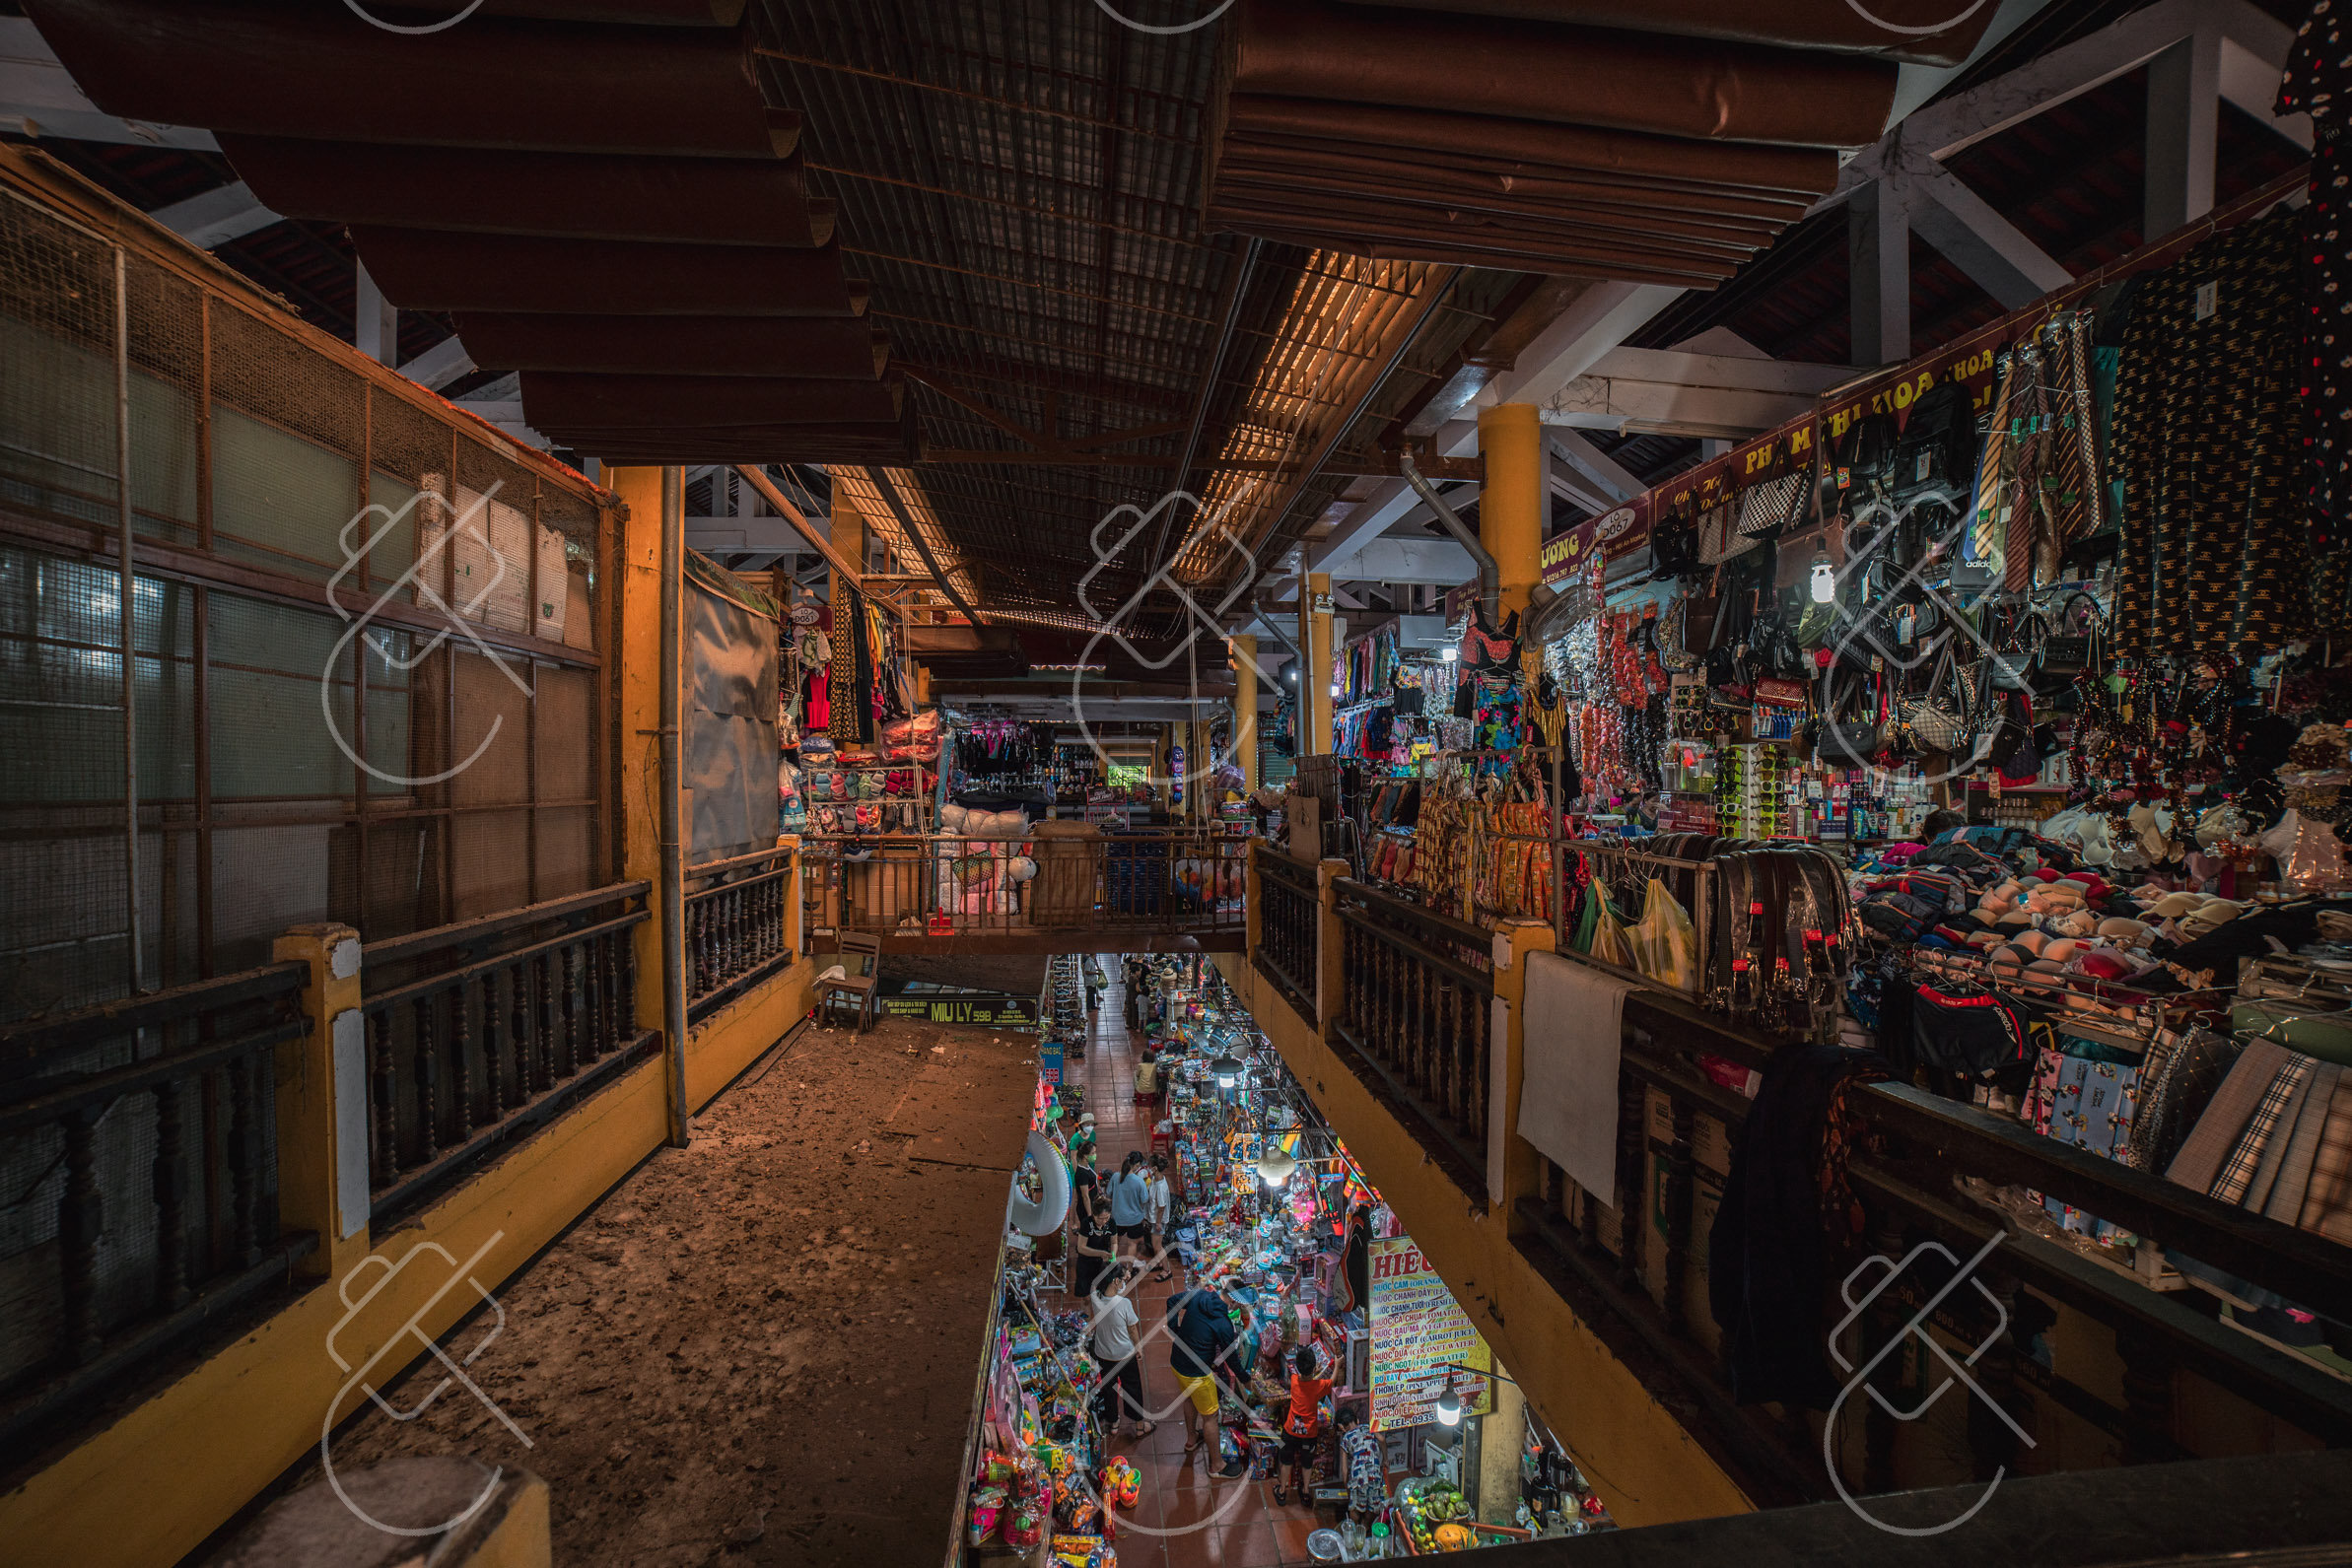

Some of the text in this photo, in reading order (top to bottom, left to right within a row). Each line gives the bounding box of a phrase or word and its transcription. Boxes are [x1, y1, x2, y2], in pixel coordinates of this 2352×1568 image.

[1745, 426, 1812, 475] PHM
[1820, 403, 1862, 439] HI
[932, 1002, 953, 1022] MIU
[956, 1002, 973, 1022] LY
[1393, 1279, 1409, 1290] CAM
[1394, 1290, 1417, 1301] CHANH
[1390, 1301, 1411, 1313] CHANH
[1419, 1331, 1453, 1343] (CARROT
[1409, 1342, 1446, 1356] (COCONUT
[1447, 1338, 1477, 1349] WATER)
[1452, 1372, 1473, 1383] RUIT)
[1414, 1403, 1435, 1413] (GUAV
[1390, 1416, 1410, 1428] TEL:
